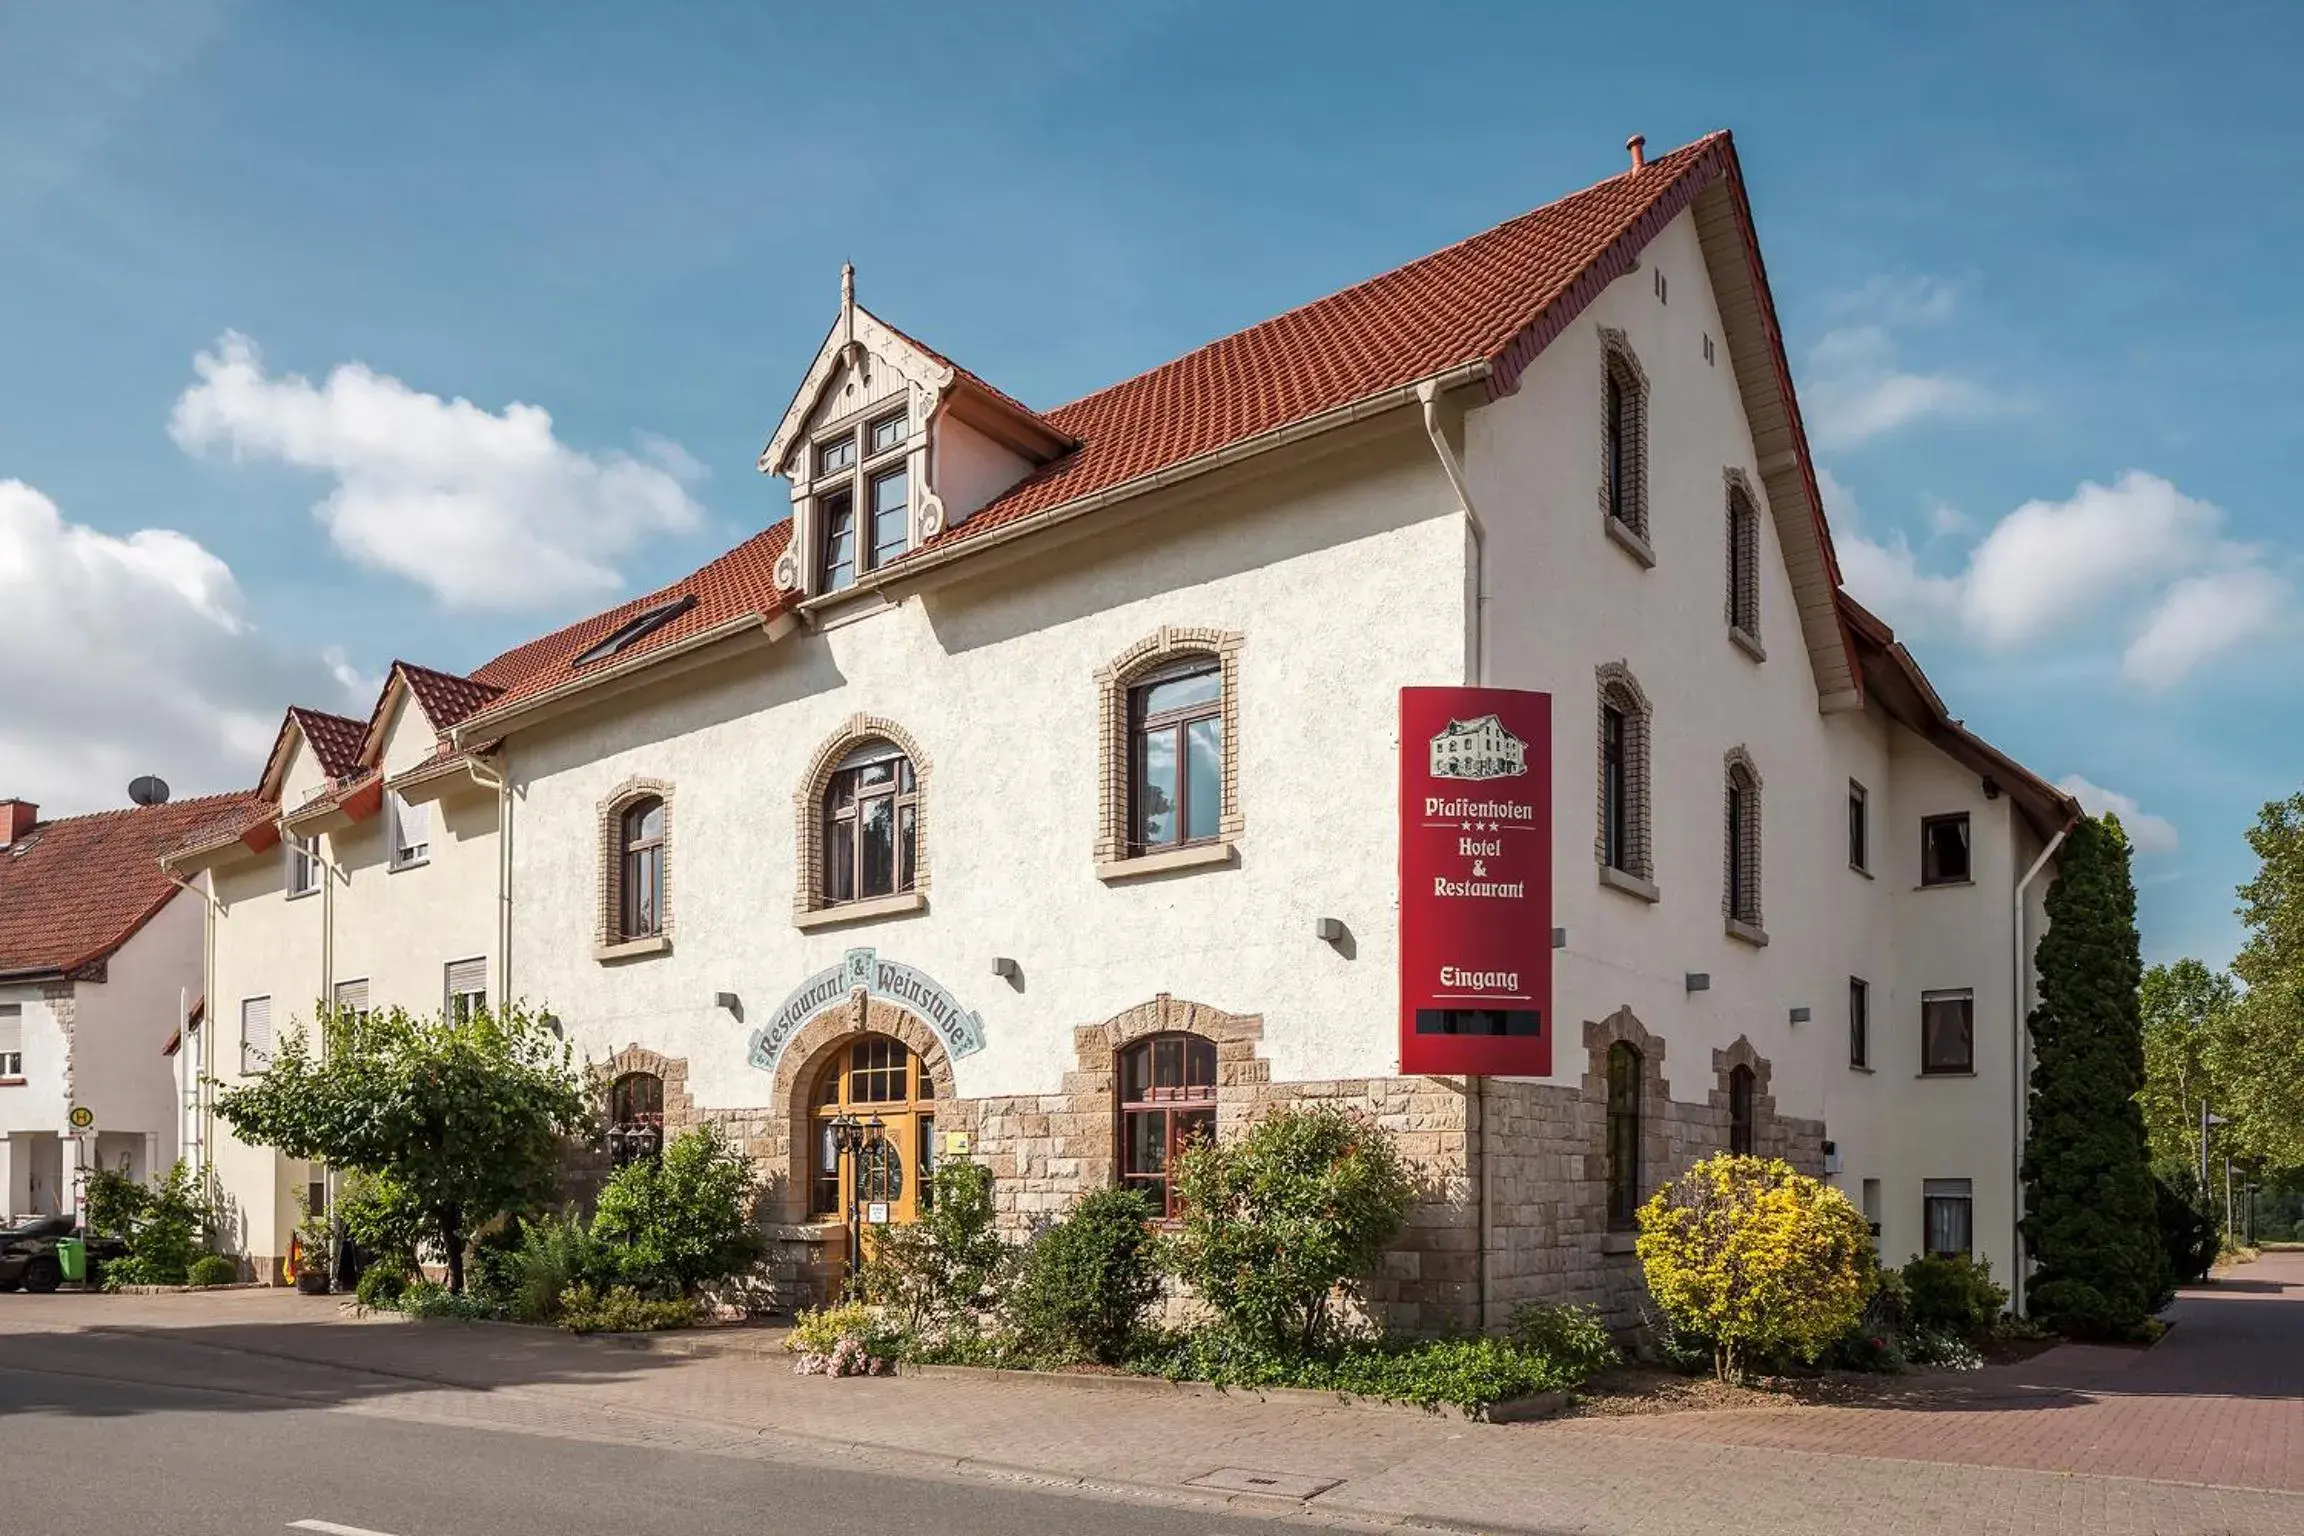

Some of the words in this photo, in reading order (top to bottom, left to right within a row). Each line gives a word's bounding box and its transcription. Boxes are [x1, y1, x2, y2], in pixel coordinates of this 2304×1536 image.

[1425, 797, 1533, 820] Pfaffenhofen
[1459, 837, 1501, 857] Hotel
[1472, 859, 1487, 878] &
[1434, 877, 1524, 898] Restaurant
[1440, 966, 1518, 991] Eingang
[760, 969, 844, 1060] Restaurant
[853, 958, 864, 976] &
[877, 963, 966, 1045] Weinstube
[76, 1111, 87, 1123] H
